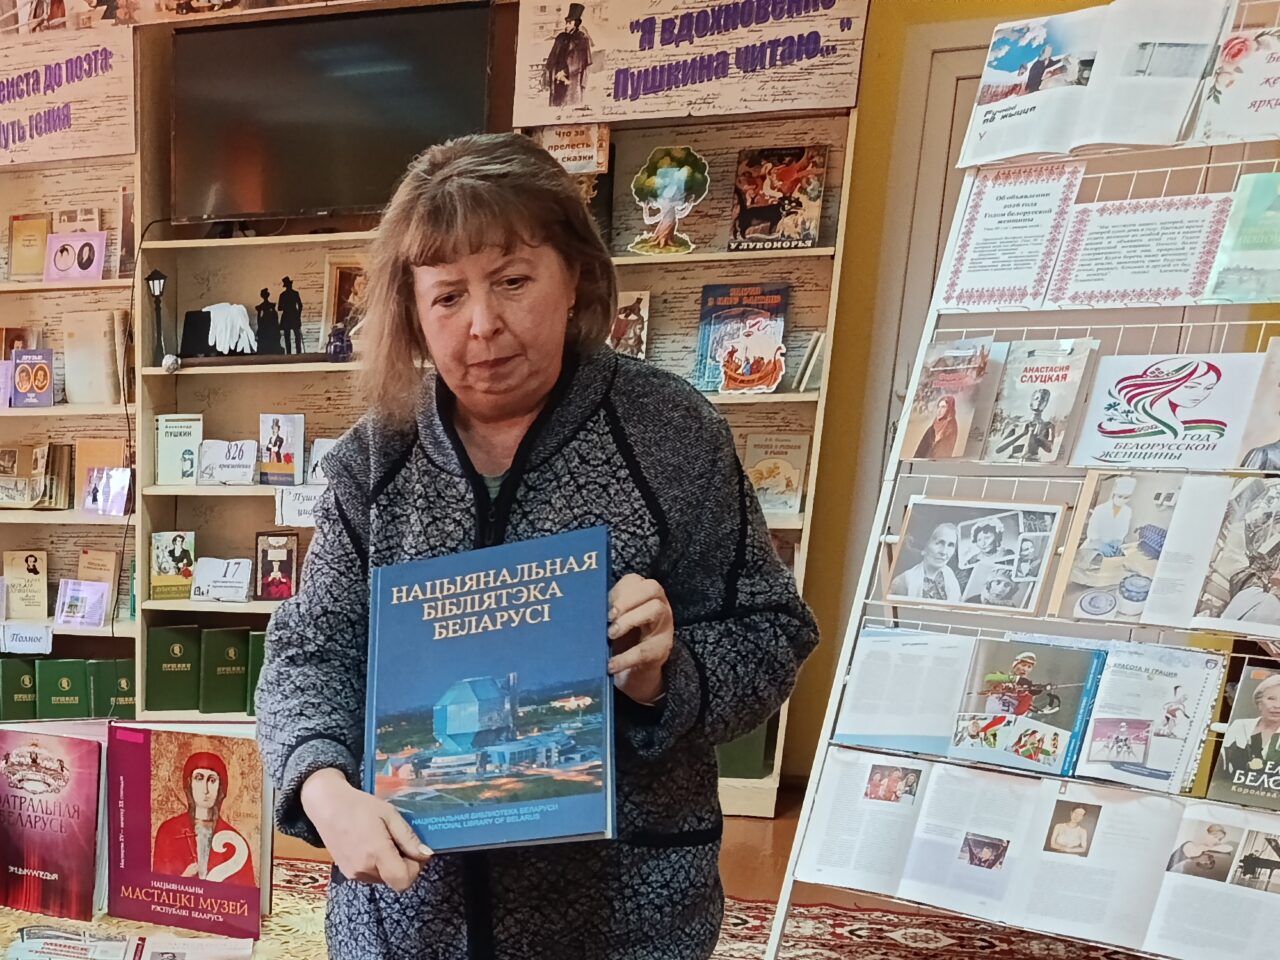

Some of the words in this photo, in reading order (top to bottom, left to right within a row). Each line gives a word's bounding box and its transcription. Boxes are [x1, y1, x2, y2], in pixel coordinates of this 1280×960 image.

[43, 62, 63, 95] до
[66, 47, 114, 83] поэта:
[612, 51, 730, 101] Пушкина
[28, 103, 72, 139] гения
[555, 130, 571, 138] Что
[547, 142, 591, 152] прелесть
[561, 154, 594, 163] сказки
[741, 239, 813, 250] ЛУКОМОРЬЯ
[1022, 365, 1070, 374] АНАСТАСИЯ
[1020, 373, 1069, 384] СЛУЦКАЯ
[164, 430, 192, 438] ПУШКИН
[1181, 433, 1210, 442] ГОД
[224, 443, 245, 461] 826
[1114, 442, 1217, 451] БЕЛОРУССКОЙ
[1099, 451, 1183, 461] ЖЕНЩИНЫ
[221, 562, 241, 579] 17
[390, 551, 599, 605] НАЦЫЯНАЛЬНАЯ
[422, 580, 564, 621] БІБЛІЯТЭКА
[432, 604, 551, 641] БЕЛАРУСІ
[9, 632, 43, 644] Полное
[428, 822, 462, 831] NATIONAL
[463, 819, 493, 828] LIBRARY
[506, 813, 540, 823] BELARUS
[151, 880, 204, 894] НАЦЫЯНАЛЬНЫ
[120, 886, 195, 909] МАСТАЦКІ
[198, 897, 249, 916] МУЗЕЙ
[151, 904, 189, 917] РЭСПУБЛІКІ
[191, 911, 224, 922] БЕЛАРУСЬ
